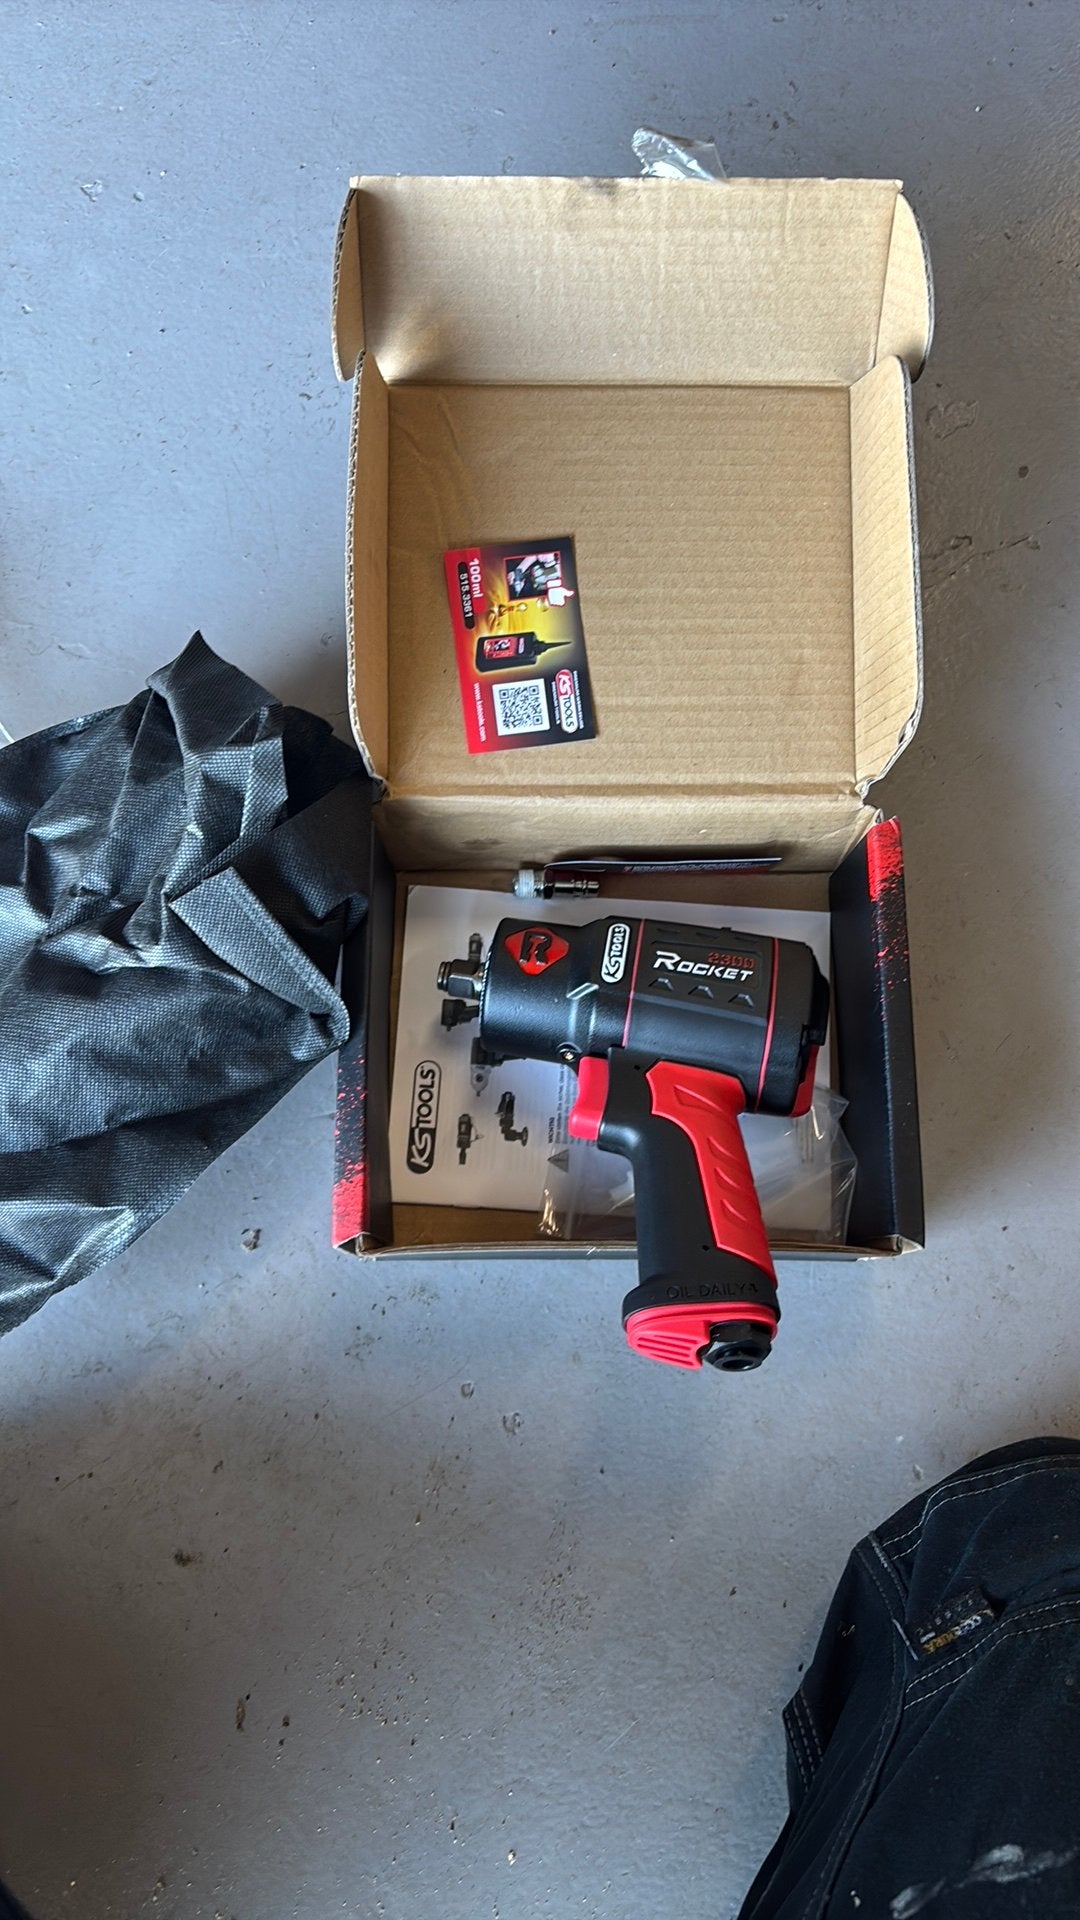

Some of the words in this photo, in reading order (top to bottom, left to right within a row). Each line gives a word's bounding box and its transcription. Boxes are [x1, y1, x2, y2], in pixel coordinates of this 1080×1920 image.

[468, 557, 484, 599] 100ml
[653, 950, 754, 982] ROCKET
[708, 951, 755, 970] 2300
[666, 1285, 695, 1299] OIL
[699, 1283, 746, 1298] DAILY
